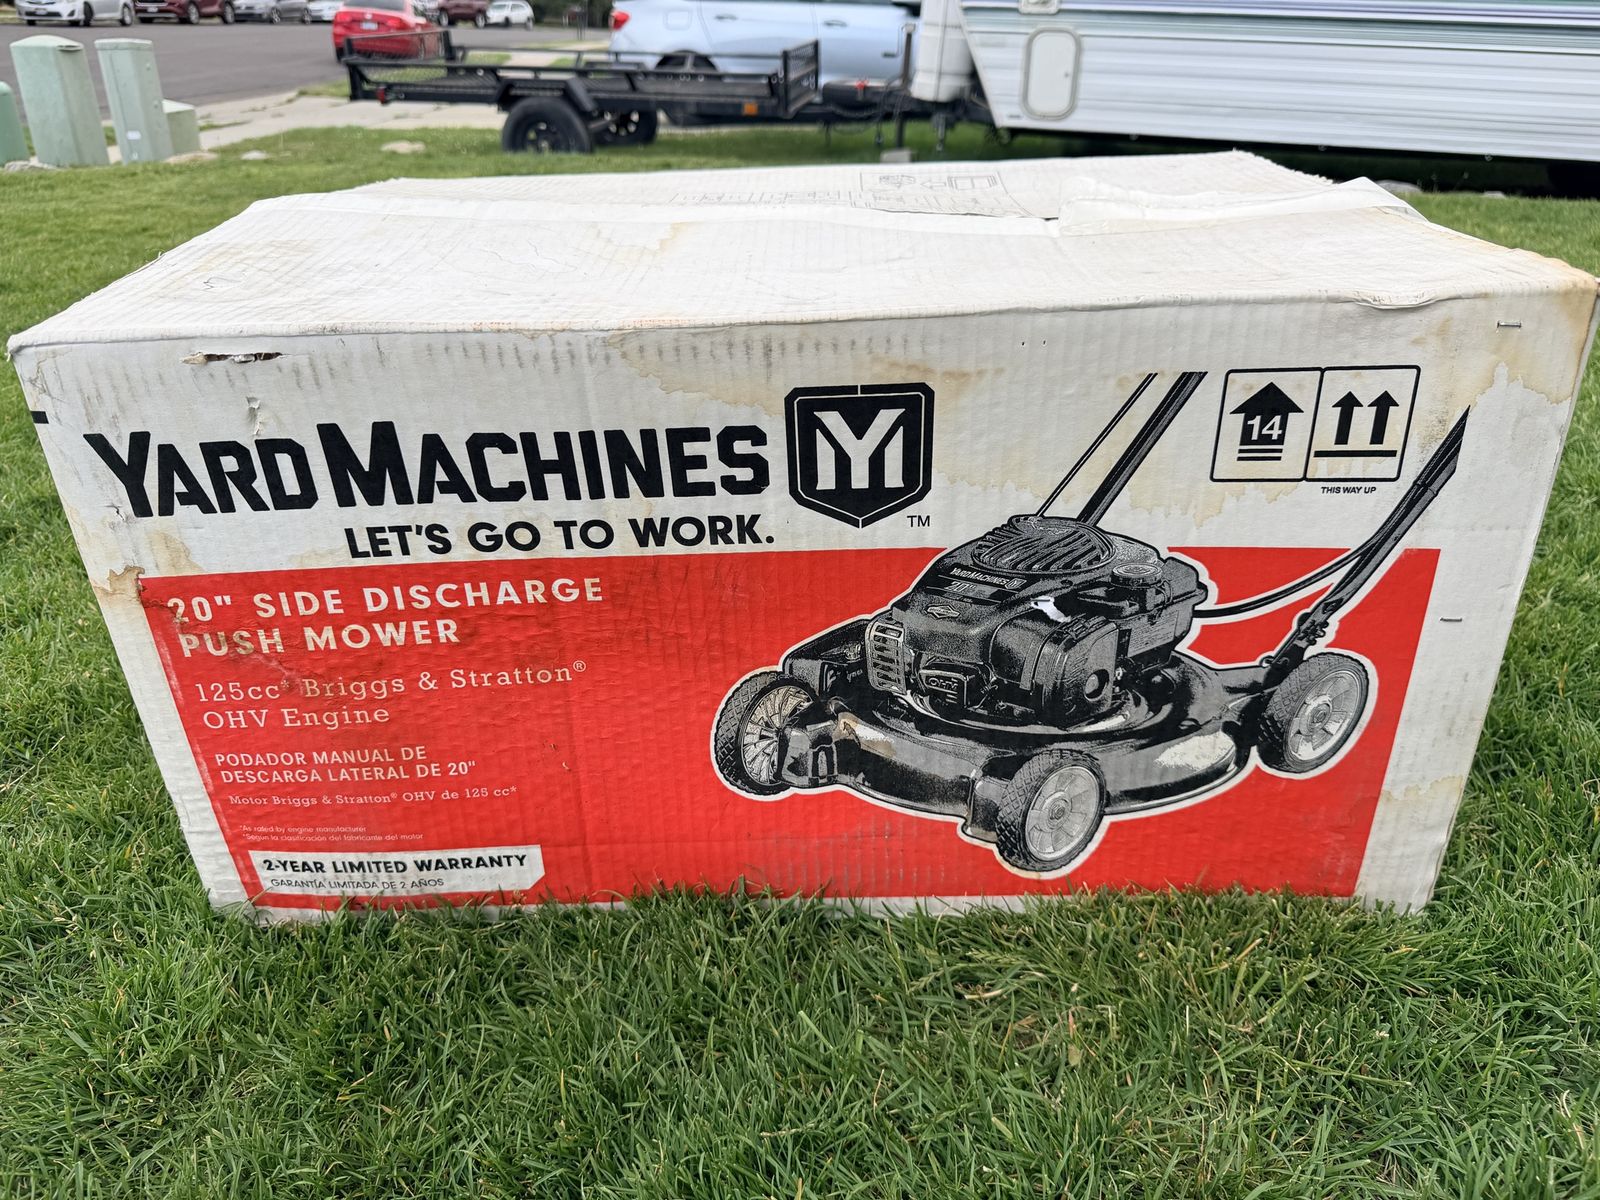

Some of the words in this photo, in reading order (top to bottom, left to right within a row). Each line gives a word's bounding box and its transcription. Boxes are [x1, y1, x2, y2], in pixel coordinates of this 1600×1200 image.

[1247, 414, 1283, 441] 14
[83, 431, 318, 517] YARD
[317, 421, 770, 507] MACHINES
[1321, 486, 1342, 494] THIS
[1342, 486, 1363, 494] WAY
[1364, 486, 1376, 494] UP
[344, 523, 452, 558] LET'S
[467, 521, 541, 552] GO
[554, 519, 614, 550] TO
[628, 514, 774, 548] WORK.
[167, 594, 232, 623] 20"
[253, 589, 344, 618] SIDE
[365, 577, 604, 613] DISCHARGE
[178, 627, 285, 658] PUSH
[304, 619, 461, 652] MOWER
[302, 676, 405, 701] Briggs
[418, 671, 439, 691] &
[203, 708, 269, 729] OHV
[281, 705, 390, 730] Engine
[215, 752, 307, 767] PODADOR
[313, 748, 394, 765] MANUAL
[401, 746, 427, 761] DE
[220, 768, 322, 783] DESCARGA
[328, 765, 410, 782] LATERAL
[416, 763, 441, 778] DE
[448, 760, 477, 776] 20"
[229, 795, 268, 805] Motor
[272, 795, 317, 807] Briggs
[322, 795, 332, 805] &
[402, 790, 436, 802] OHV
[441, 790, 459, 800] de
[465, 787, 489, 798] 125
[263, 859, 326, 873] 2-YEAR
[332, 860, 408, 874] LIMITED
[414, 854, 527, 873] WARRANTY
[270, 879, 326, 889] GARANTÍA
[328, 879, 379, 890] LIMITADA
[382, 880, 398, 890] DE
[400, 880, 407, 888] 2
[410, 878, 445, 888] AÑOS
